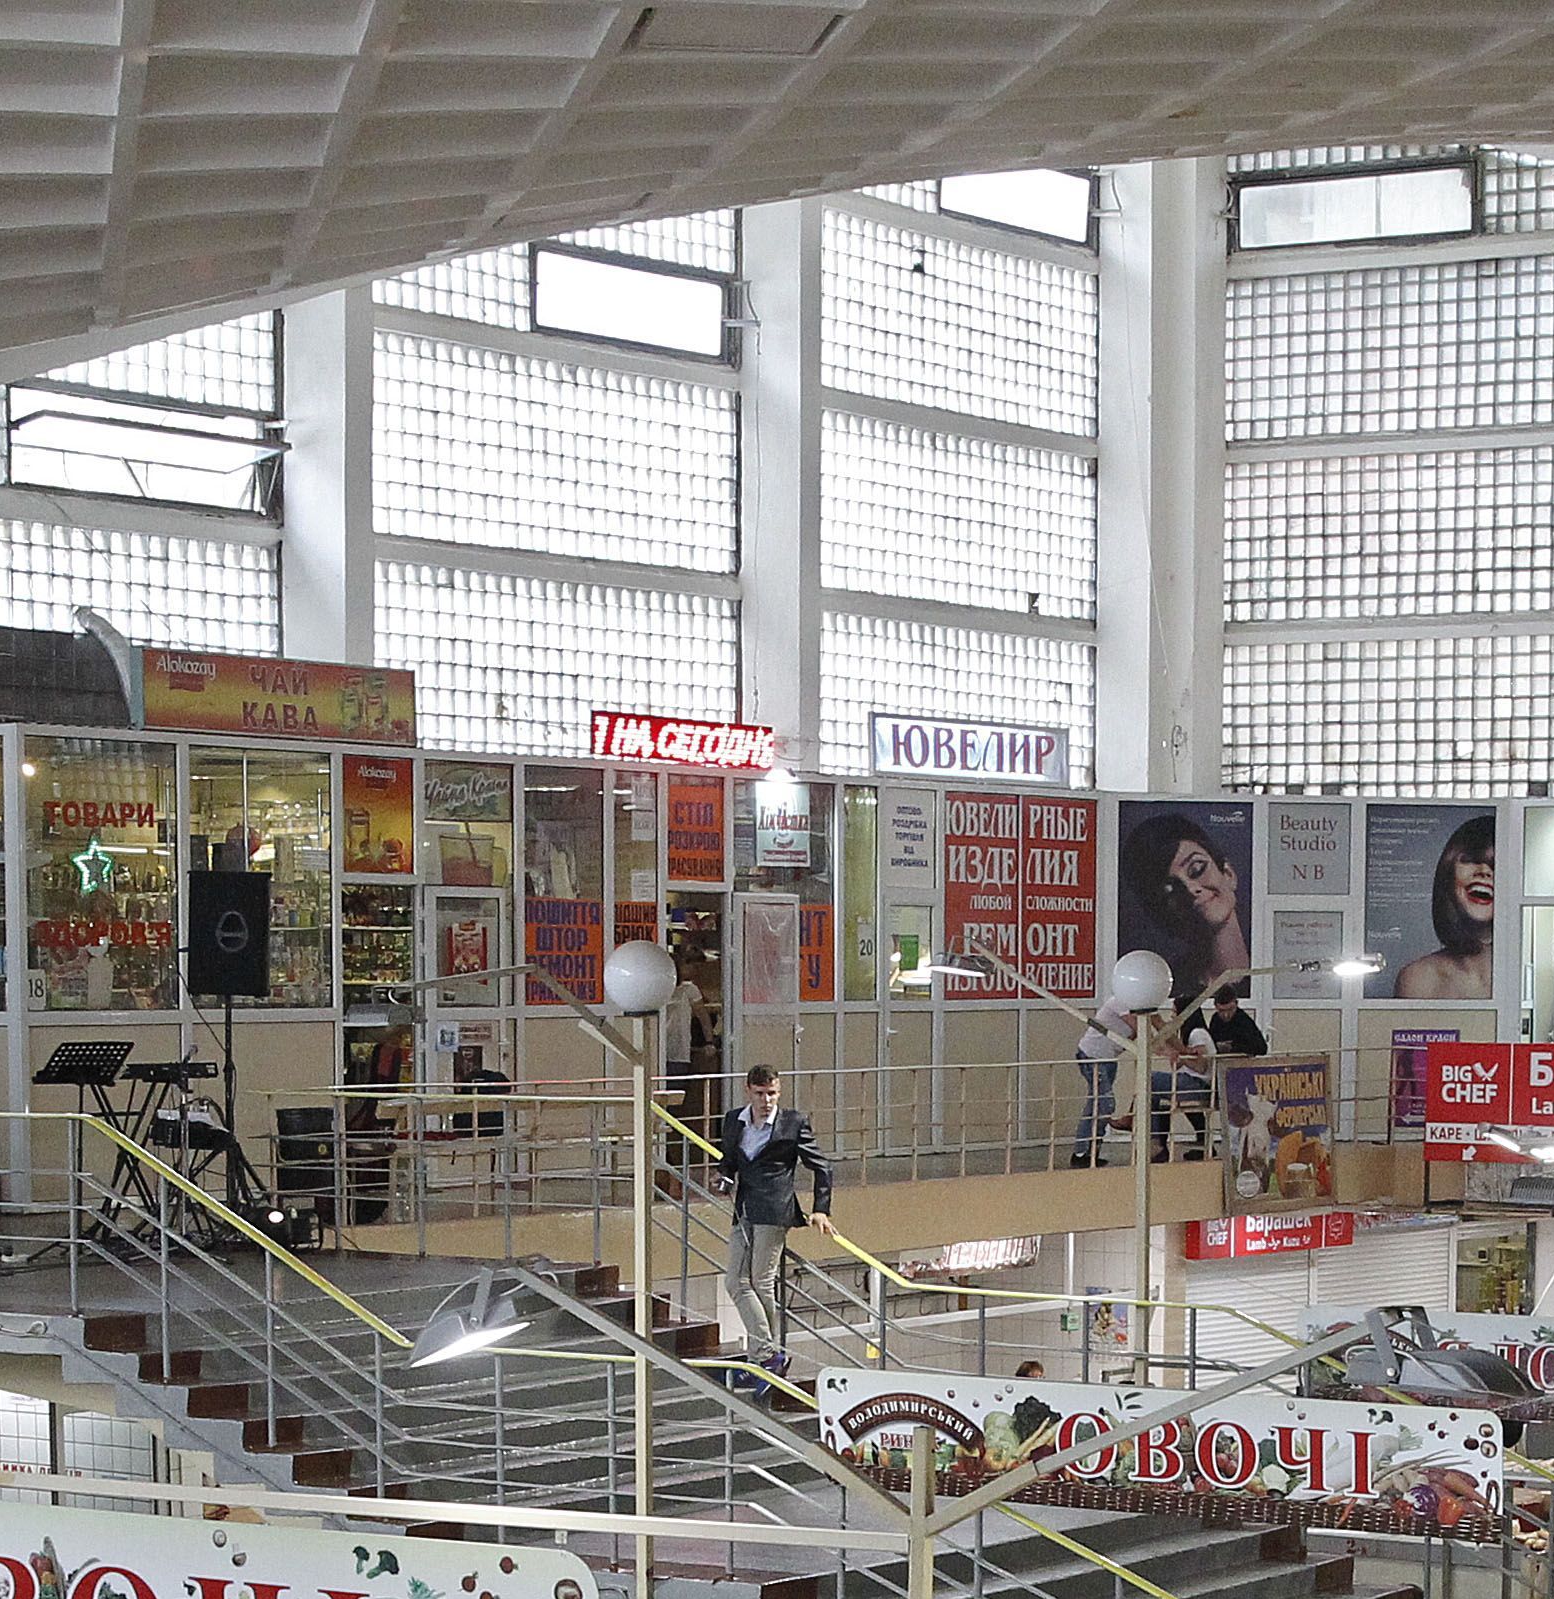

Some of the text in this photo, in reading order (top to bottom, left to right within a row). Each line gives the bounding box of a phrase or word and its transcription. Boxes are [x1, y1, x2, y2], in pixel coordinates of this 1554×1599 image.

[156, 654, 216, 680] Alokozay
[248, 663, 309, 696] ЧАЙ
[241, 700, 319, 733] КАВА
[891, 724, 1055, 777] ЮВЕЛИР
[44, 801, 155, 828] ТОВАРИ
[1280, 814, 1338, 836] Beauty
[1280, 834, 1337, 852] Studio
[1292, 865, 1325, 881] N B
[969, 894, 1094, 913] ЛЮБОЙ СЛОЖНОСТИ
[536, 925, 588, 951] ШТОР
[859, 939, 873, 956] 20
[28, 978, 44, 998] 18
[1441, 1065, 1472, 1082] BIG
[1441, 1084, 1499, 1104] CHEF
[1430, 1126, 1462, 1141] КАРЕ
[847, 1400, 975, 1442] ВОЛОДИМИРСЬКИЙ
[1055, 1410, 1381, 1500] ОВОЧІ
